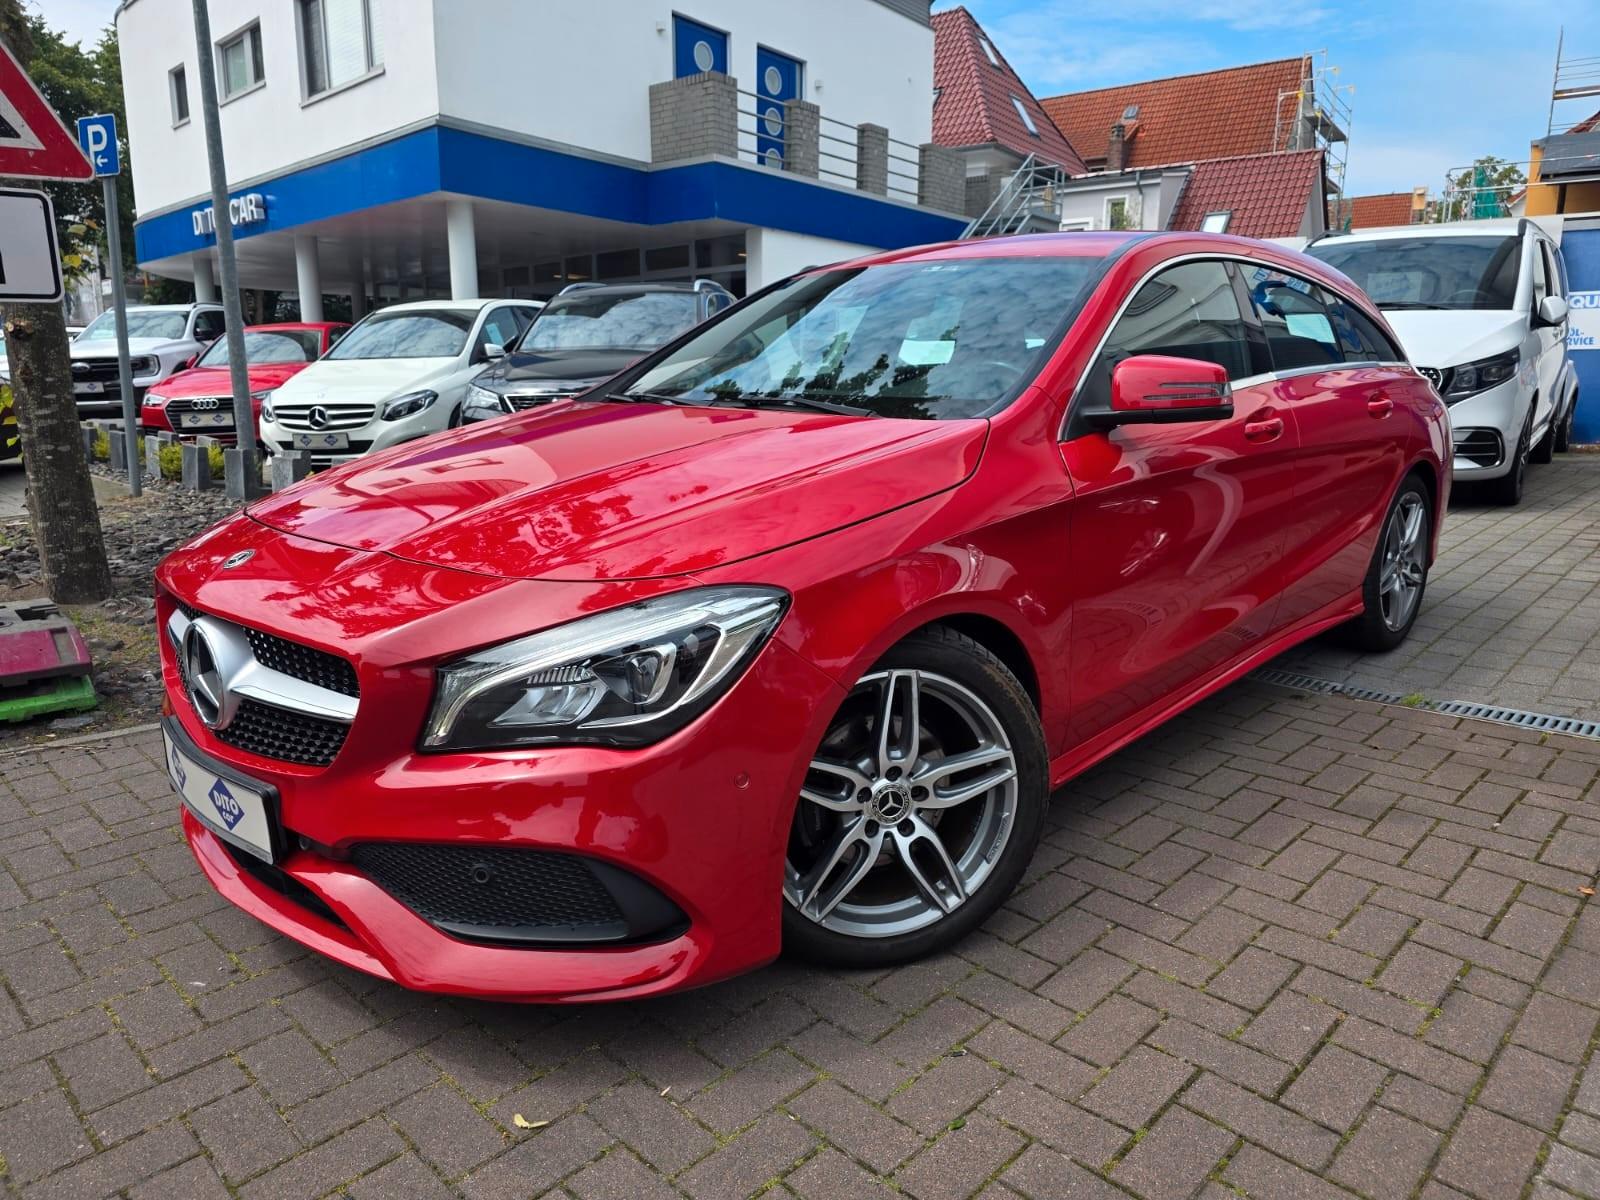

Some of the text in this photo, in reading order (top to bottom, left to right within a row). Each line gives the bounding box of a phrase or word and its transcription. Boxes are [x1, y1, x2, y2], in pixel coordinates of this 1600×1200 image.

[87, 124, 107, 165] P
[229, 193, 264, 226] CAR
[212, 789, 239, 816] DITO
